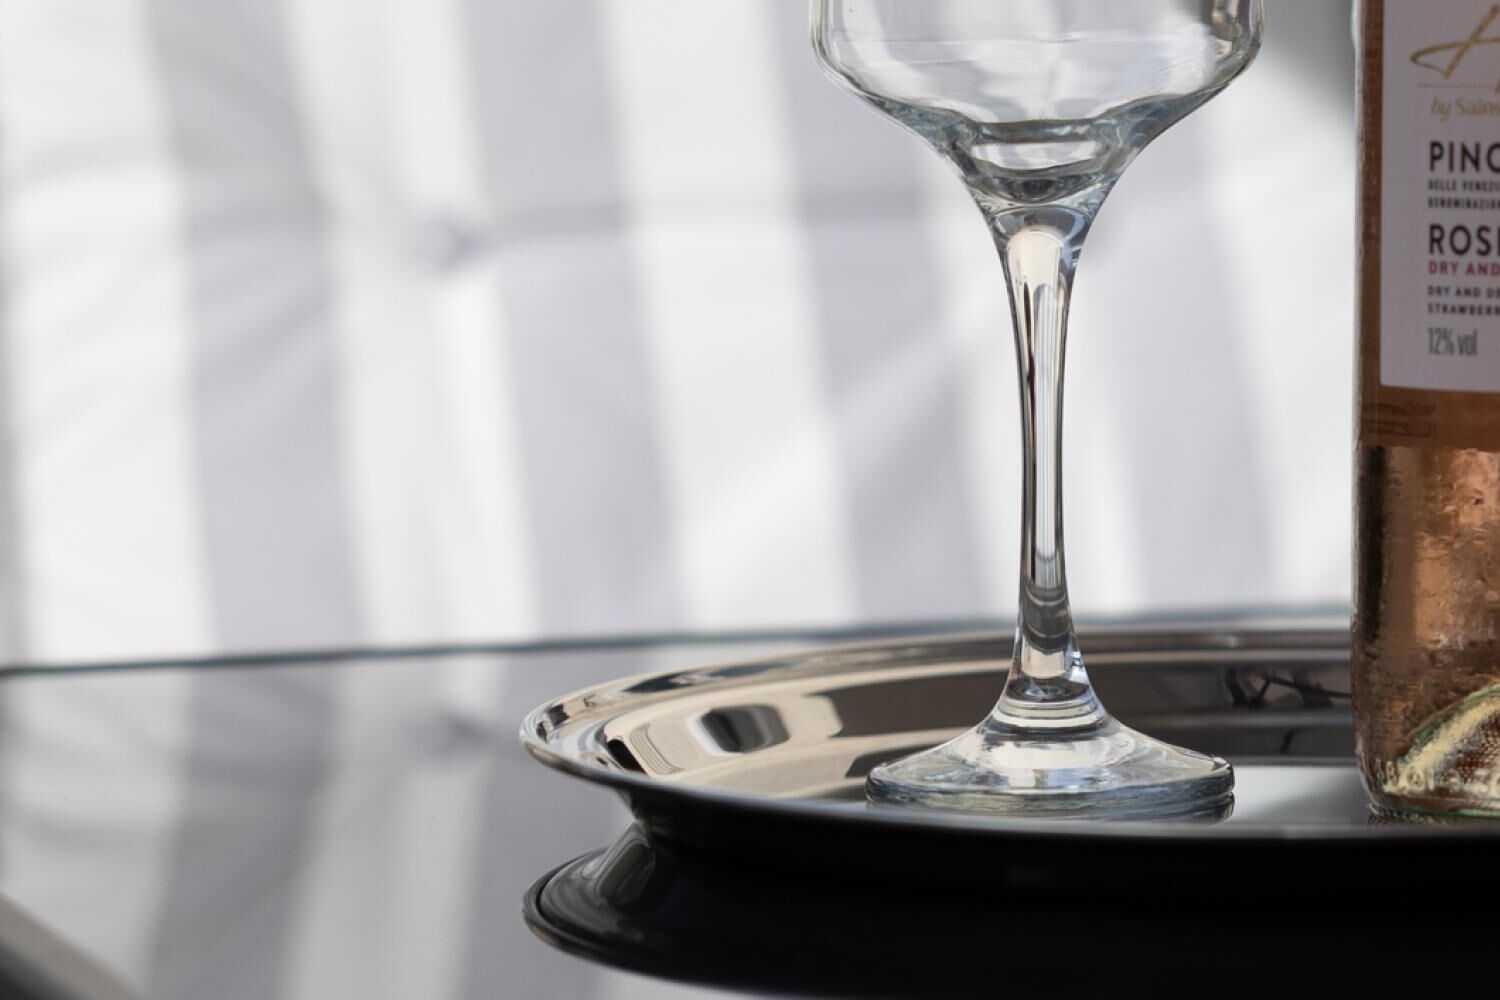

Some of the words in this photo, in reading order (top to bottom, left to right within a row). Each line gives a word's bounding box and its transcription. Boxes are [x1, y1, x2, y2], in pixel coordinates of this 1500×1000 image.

[1430, 97, 1451, 121] by
[1428, 179, 1457, 192] DELLE
[1428, 261, 1459, 276] DRY
[1427, 285, 1451, 297] DRY
[1455, 286, 1481, 298] AND
[1428, 327, 1455, 355] 12%
[1457, 329, 1478, 356] vol
